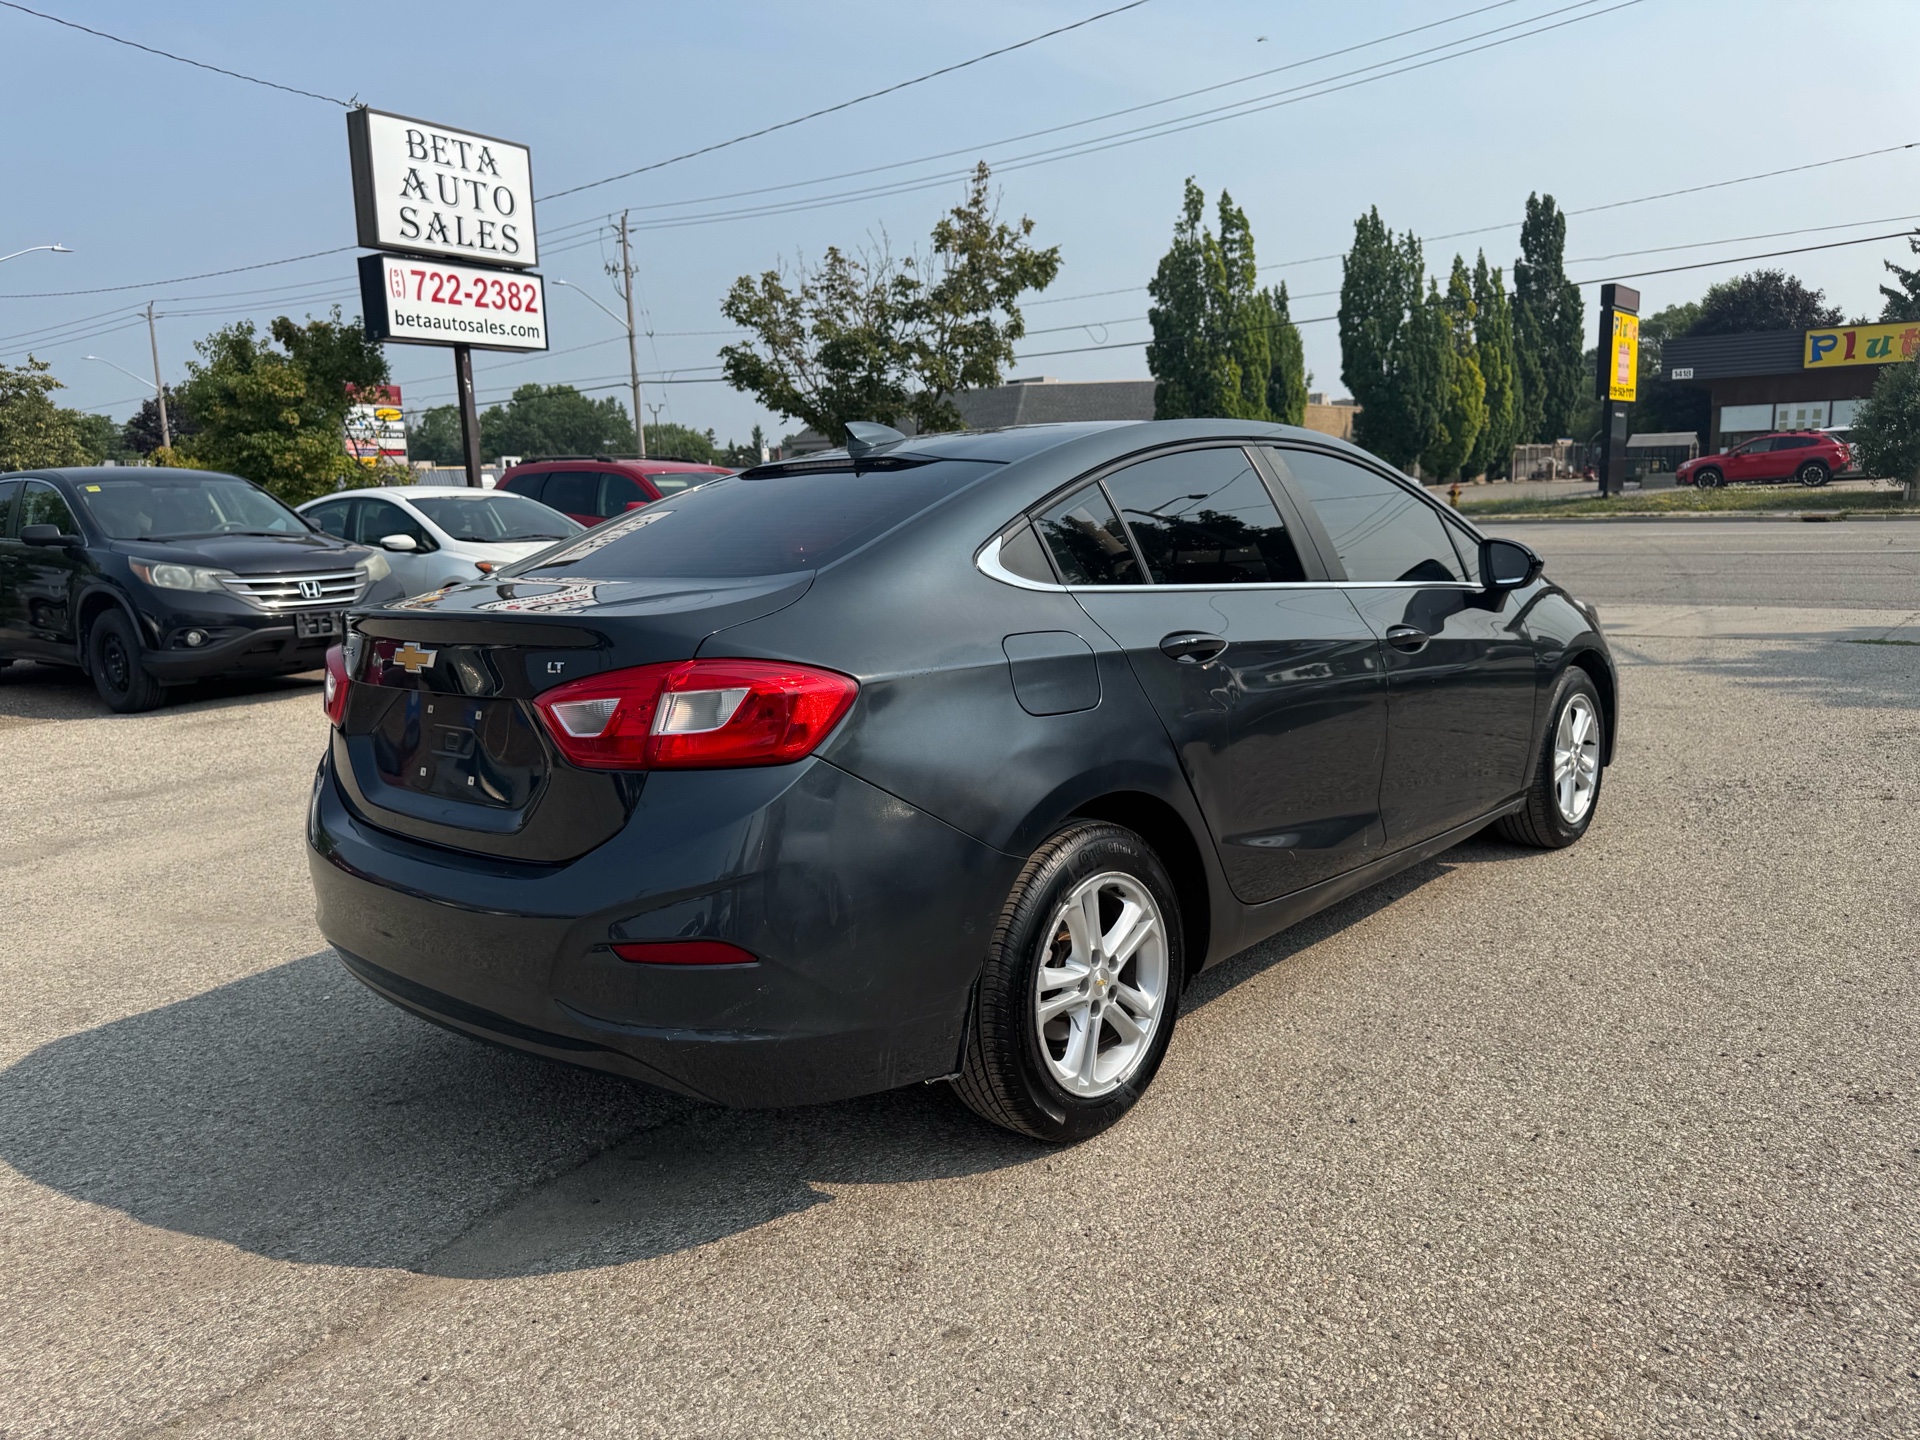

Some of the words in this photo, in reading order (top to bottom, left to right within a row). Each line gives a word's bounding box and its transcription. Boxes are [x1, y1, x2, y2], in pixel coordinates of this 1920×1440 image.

[405, 129, 500, 177] BETA
[399, 167, 517, 217] AUTO
[399, 206, 519, 255] SALES
[411, 269, 538, 314] 722-2382
[395, 310, 540, 339] betaautosales.com
[547, 661, 565, 673] LT
